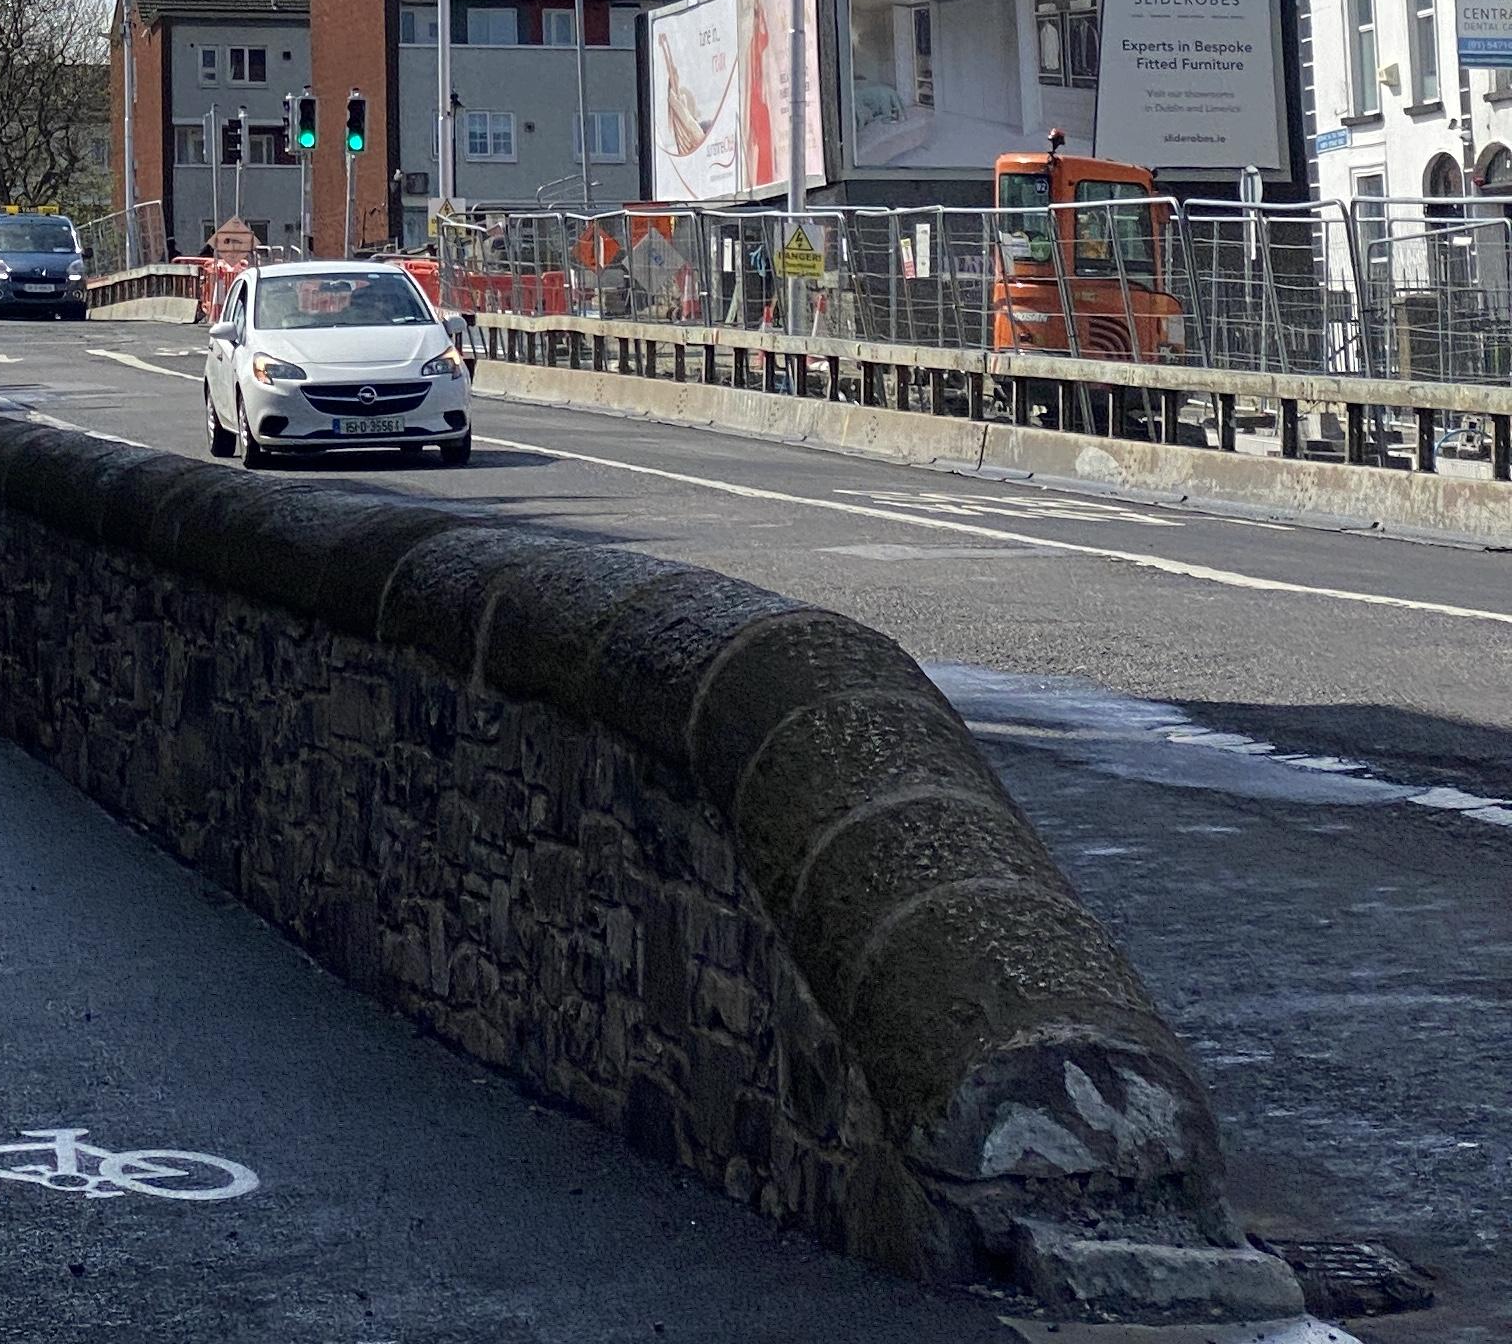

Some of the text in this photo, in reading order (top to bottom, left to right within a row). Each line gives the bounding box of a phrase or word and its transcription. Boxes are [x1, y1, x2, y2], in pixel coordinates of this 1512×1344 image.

[1122, 39, 1253, 56] Experts in Bespoke
[1137, 57, 1244, 71] Fitted Furniture
